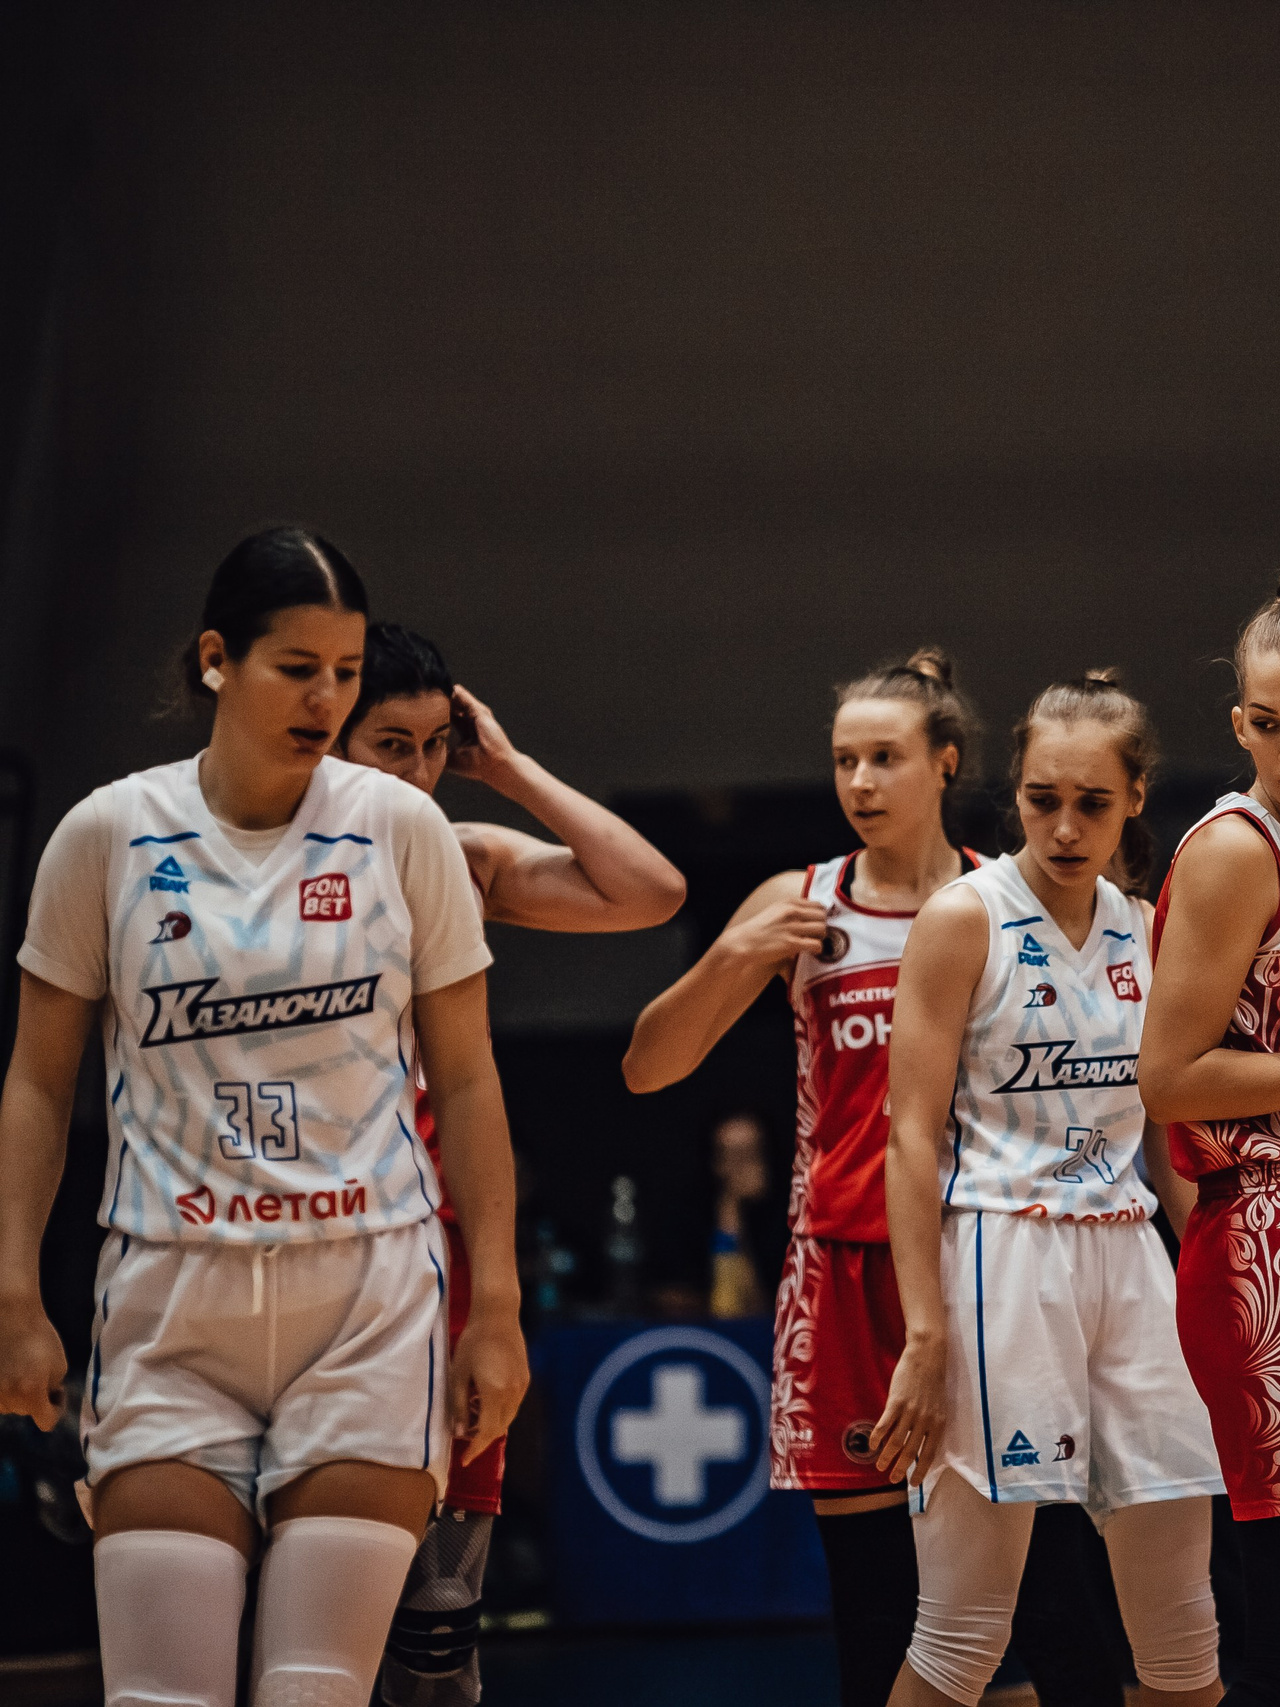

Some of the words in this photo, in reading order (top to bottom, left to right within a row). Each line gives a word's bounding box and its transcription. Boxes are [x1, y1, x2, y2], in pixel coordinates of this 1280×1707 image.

[303, 877, 346, 899] FON
[303, 896, 346, 917] BET
[214, 1081, 300, 1162] 33
[1053, 1126, 1115, 1185] 24
[227, 1178, 366, 1223] летай
[1001, 1452, 1041, 1468] PEAK
